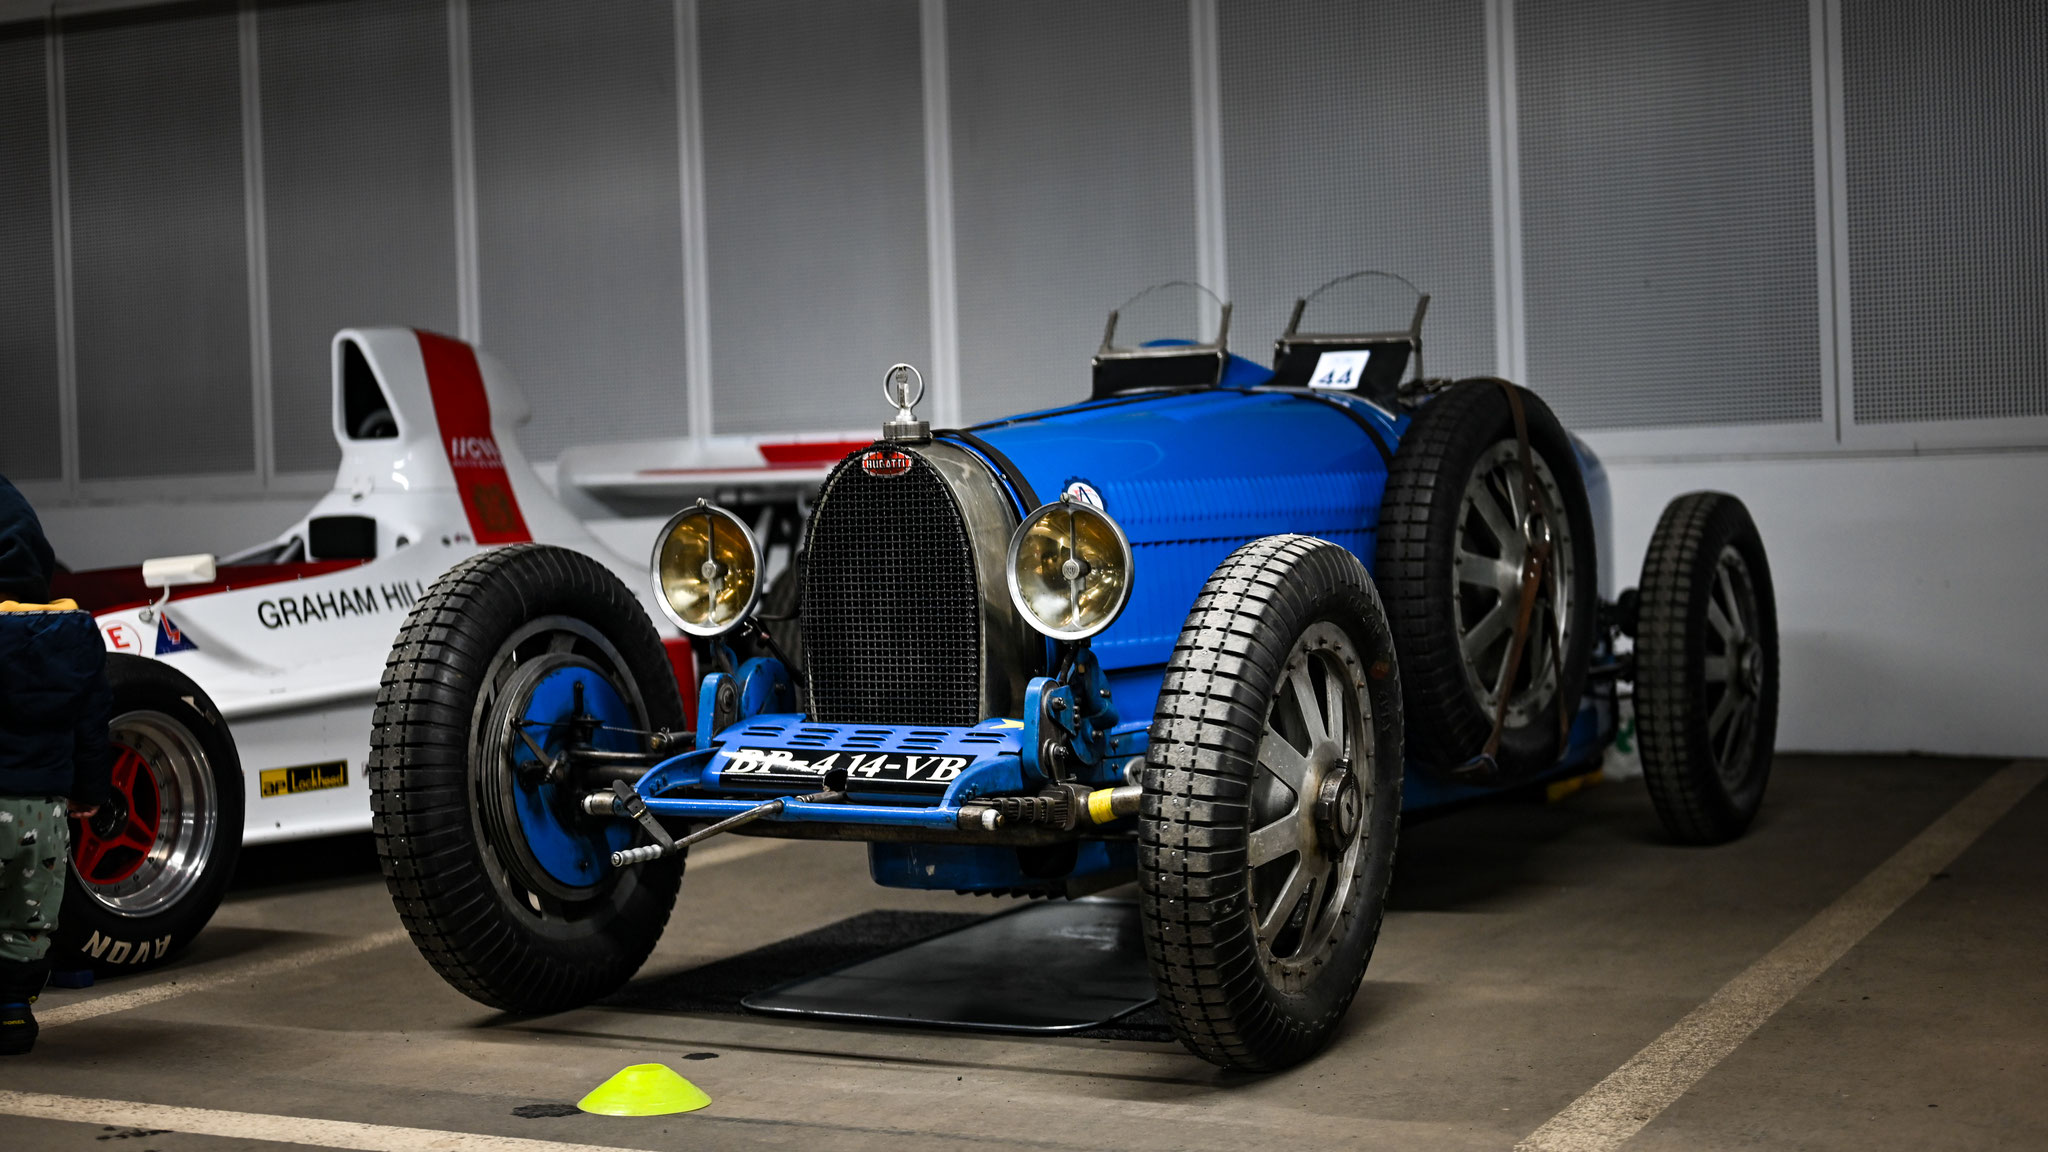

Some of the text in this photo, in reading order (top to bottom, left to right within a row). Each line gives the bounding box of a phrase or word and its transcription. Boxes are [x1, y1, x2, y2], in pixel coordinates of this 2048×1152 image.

[1319, 366, 1353, 384] 44
[257, 585, 379, 630] GRAHAM
[81, 930, 172, 964] AVON
